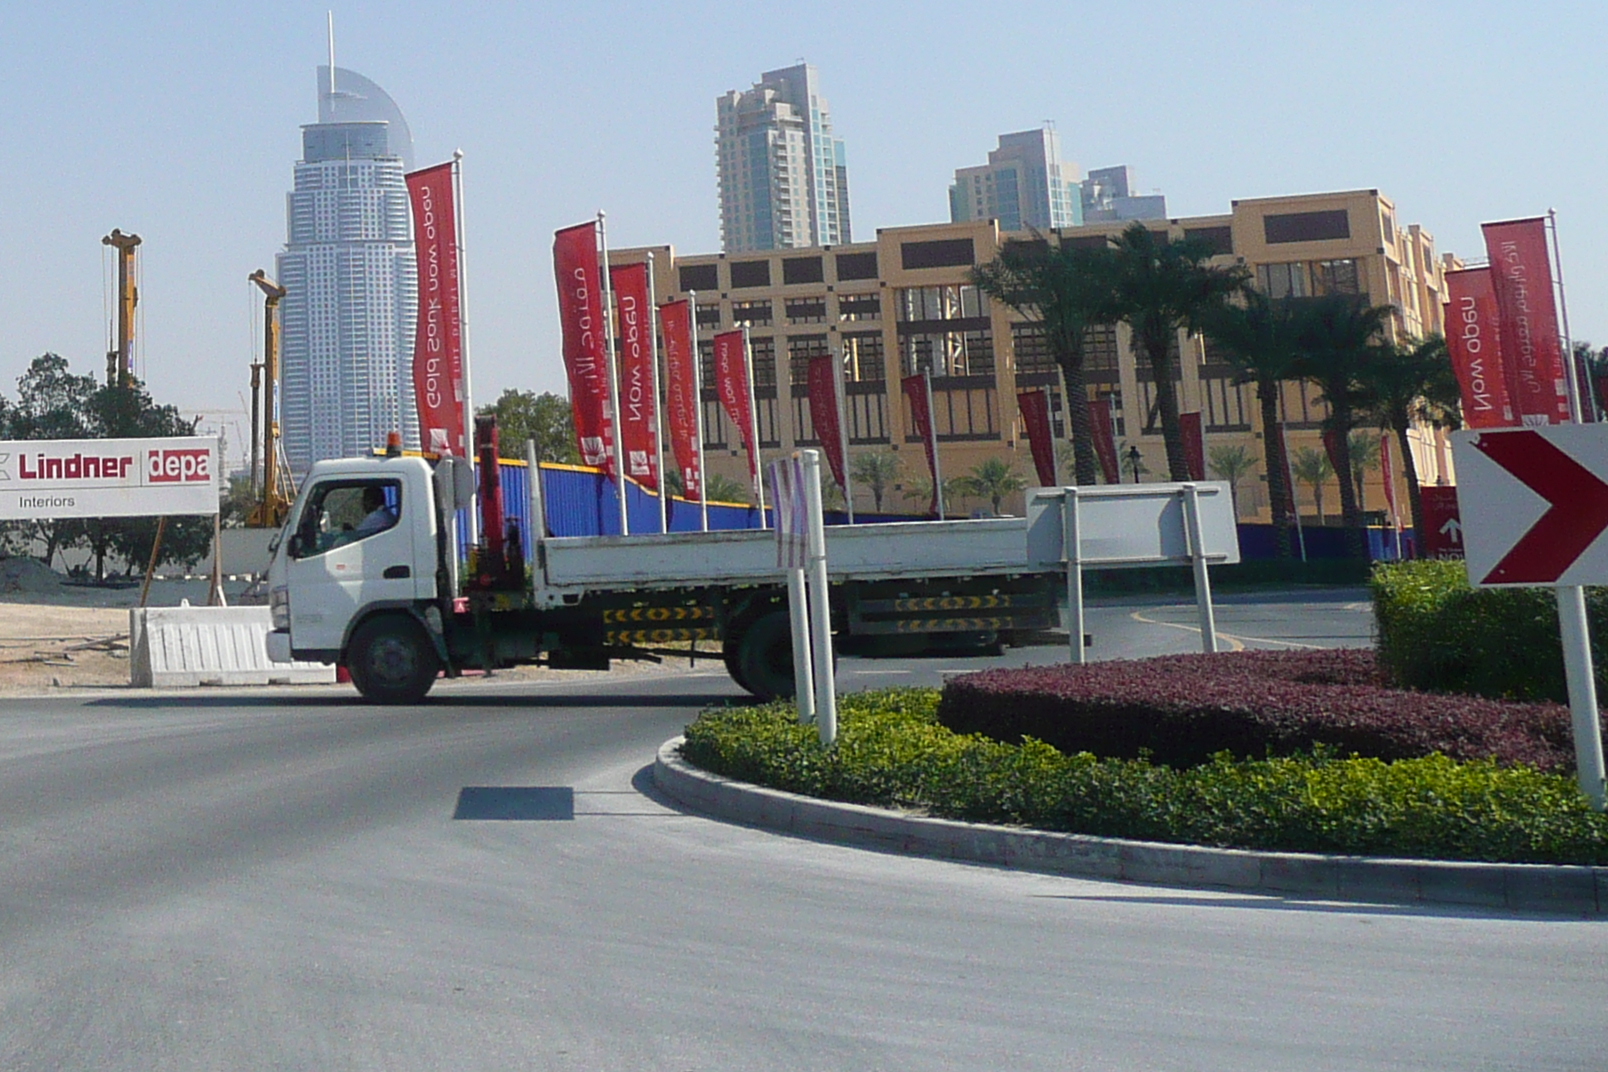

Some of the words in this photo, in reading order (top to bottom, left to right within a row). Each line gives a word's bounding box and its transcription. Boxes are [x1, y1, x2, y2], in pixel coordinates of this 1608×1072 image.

[19, 454, 133, 479] Lindner
[148, 450, 210, 481] depa
[19, 496, 76, 508] Interiors
